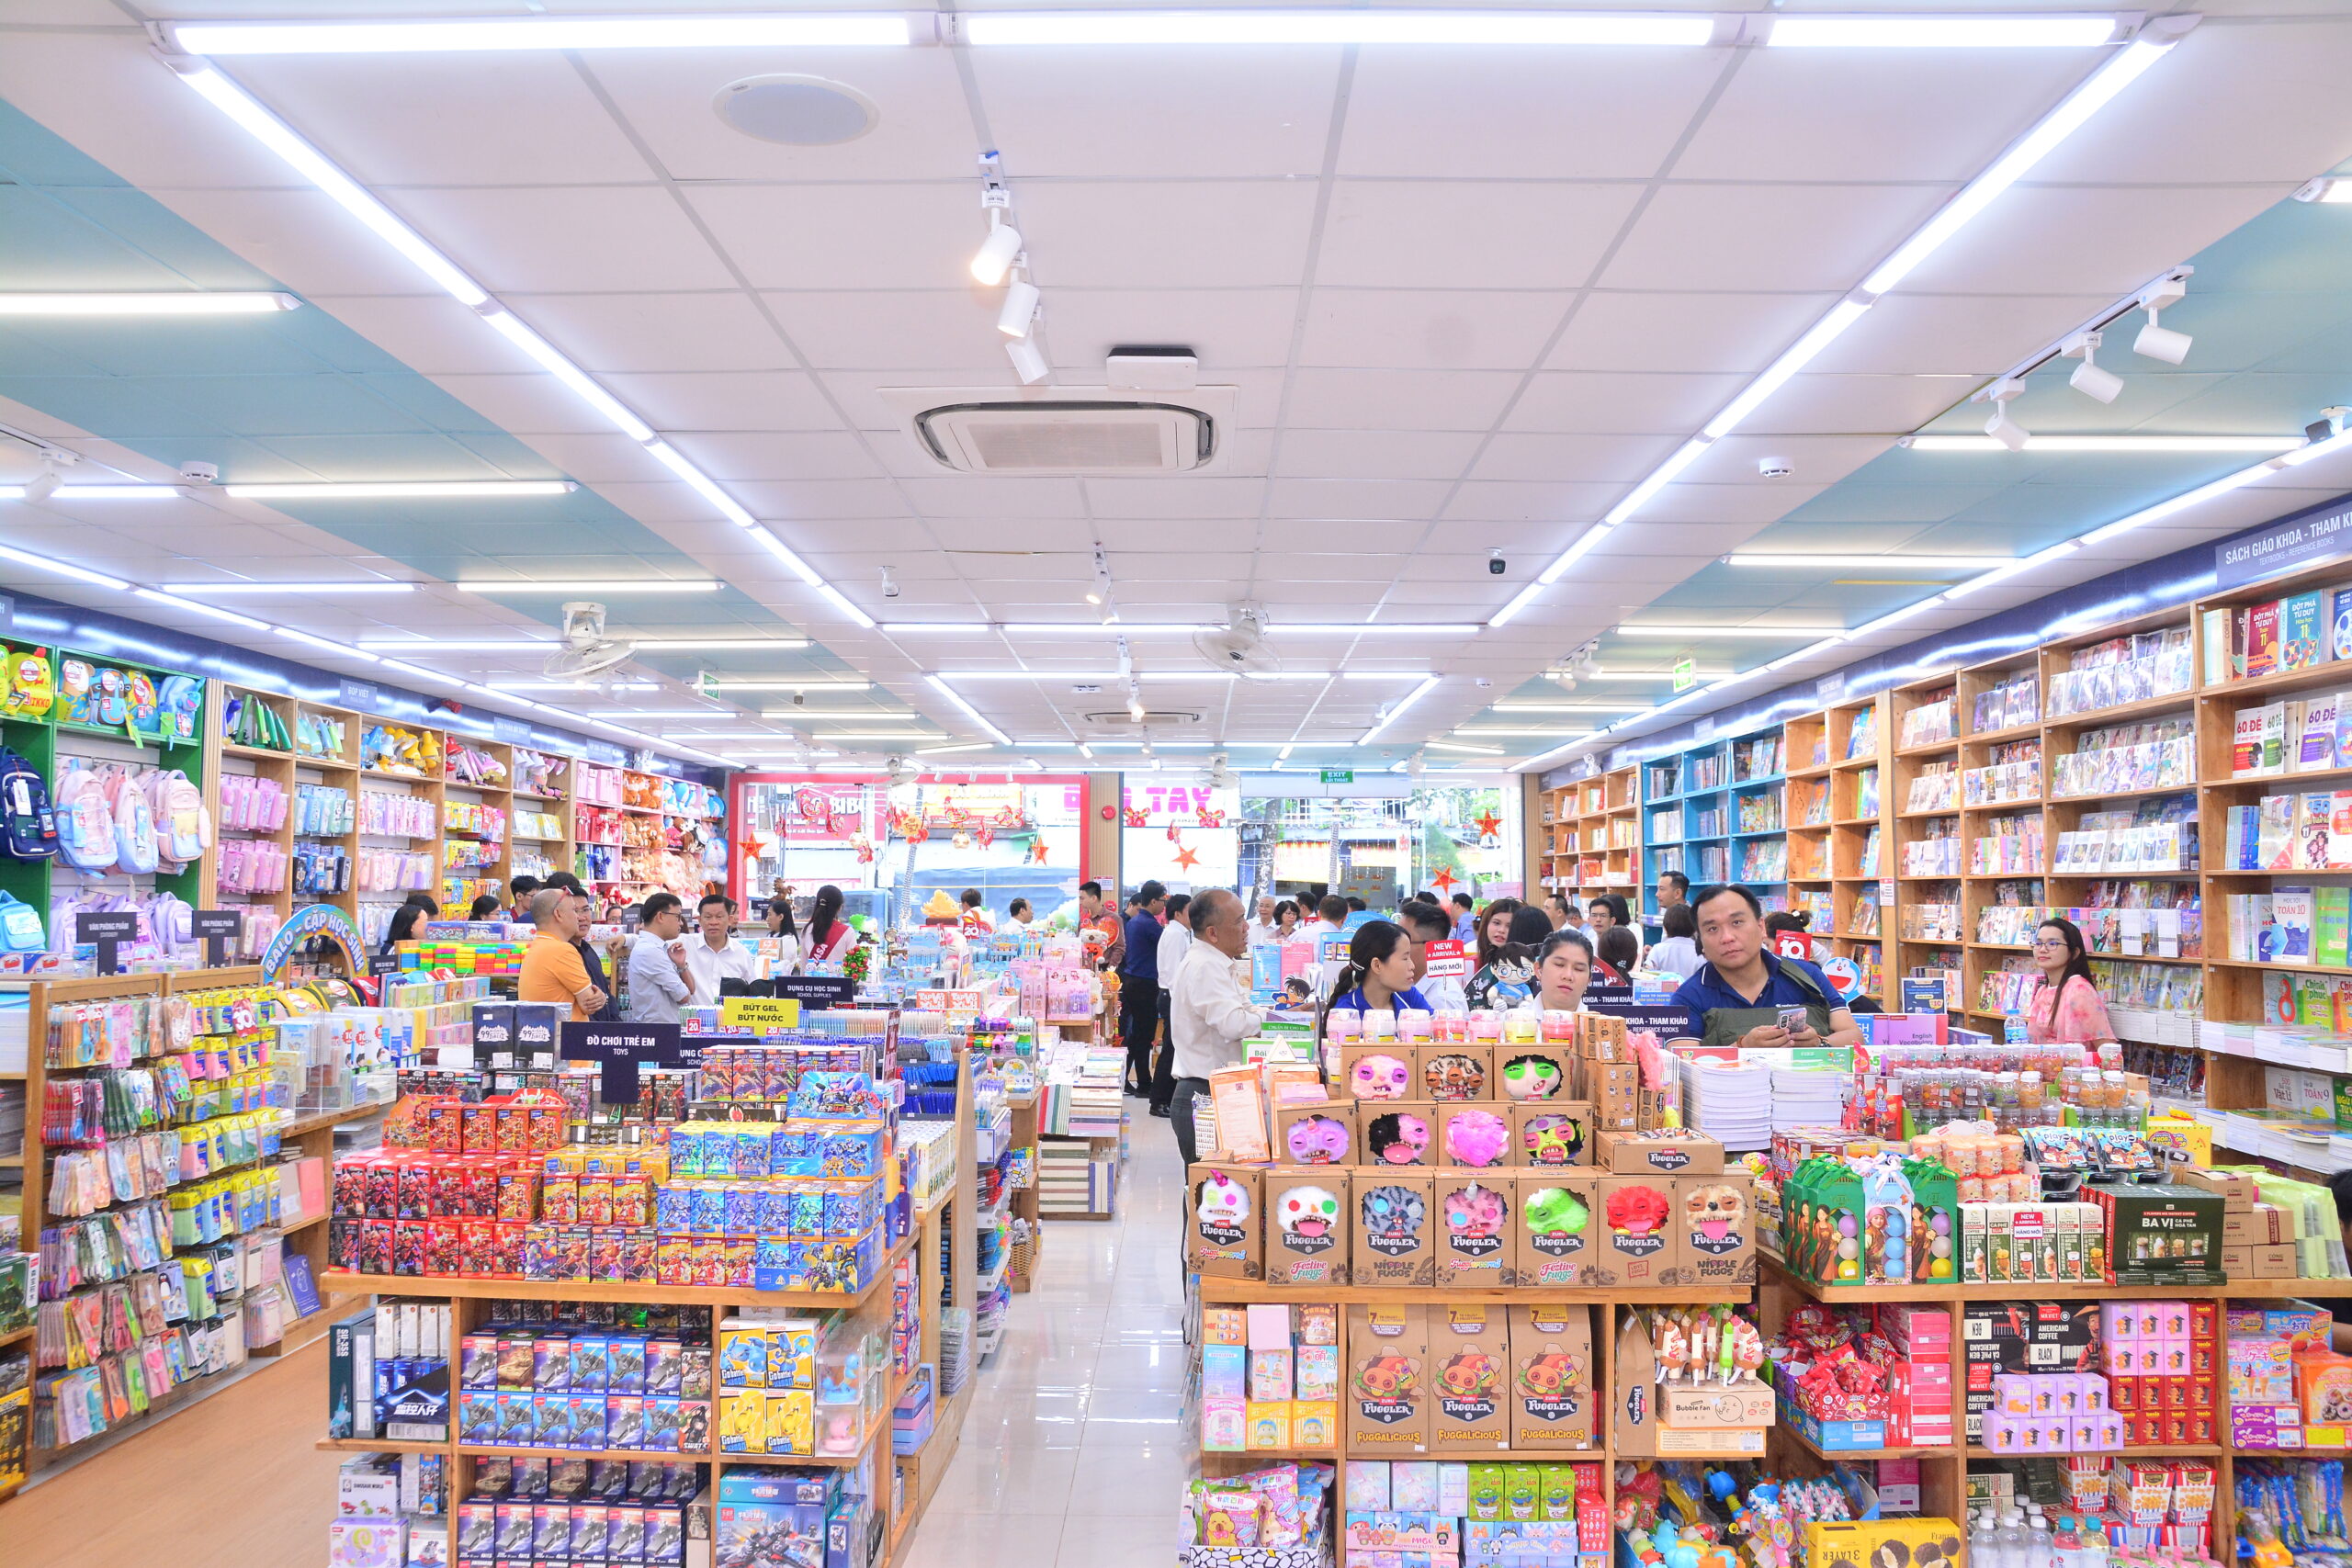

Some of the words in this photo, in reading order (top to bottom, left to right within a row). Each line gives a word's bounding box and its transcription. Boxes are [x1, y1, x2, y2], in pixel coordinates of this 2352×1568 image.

[2225, 545, 2250, 565] SÁCH
[2252, 536, 2274, 557] GIÁO
[2276, 528, 2302, 549] KHOA
[2310, 514, 2340, 538] THAM
[2259, 551, 2285, 566] TEXTBOOKS
[2289, 543, 2316, 558] REFERENCE
[2316, 536, 2335, 550] BOOKS
[2309, 710, 2320, 724] 60
[2236, 721, 2247, 734] 60
[2277, 905, 2296, 915] TOÁN
[2297, 905, 2306, 915] 10
[266, 931, 294, 975] BALO
[304, 906, 326, 935] CẶP
[328, 912, 349, 938] HỌC
[345, 931, 366, 973] SINH
[1434, 942, 1453, 951] NEW
[1429, 962, 1447, 972] HÀNG
[1448, 962, 1463, 970] MỚI
[787, 985, 804, 993] DỤNG
[805, 985, 813, 994] CỤ
[814, 986, 827, 995] HỌC
[828, 986, 842, 994] SINH
[743, 1003, 761, 1011] BÚT
[763, 1004, 779, 1012] GEL
[738, 1012, 755, 1021] BÚT
[757, 1013, 784, 1022] NƯỚC
[1669, 1015, 1689, 1024] KHẢO
[586, 1033, 600, 1046] ĐỒ
[601, 1035, 623, 1046] CHƠI
[624, 1033, 640, 1046] TRẺ
[641, 1036, 656, 1046] EM
[613, 1048, 629, 1056] TOYS
[2304, 1088, 2323, 1100] TOÁN
[1650, 1154, 1689, 1163] FUGGLER
[2142, 1217, 2159, 1227] BA
[2161, 1217, 2174, 1229] VỊ
[1202, 1224, 1244, 1239] FUGGLER
[1284, 1235, 1333, 1247] FUGGLER
[1370, 1235, 1418, 1247] FUGGLER
[1453, 1236, 1501, 1248] FUGGLER
[1534, 1236, 1582, 1248] FUGGLER
[1615, 1235, 1664, 1247] FUGGLER
[1693, 1234, 1742, 1246] FUGGLER
[1291, 1258, 1328, 1273] Festive
[1540, 1260, 1577, 1276] Festive
[1377, 1269, 1410, 1278] FUGGS
[1701, 1268, 1734, 1277] FUGGS
[1369, 1312, 1377, 1323] 7
[1450, 1311, 1457, 1323] 7
[1532, 1310, 1539, 1322] 7
[2038, 1348, 2052, 1360] BLACK
[1363, 1403, 1412, 1416] FUGGLER
[1444, 1401, 1490, 1415] FUGGLER
[1528, 1400, 1575, 1413] FUGGLER
[1634, 1387, 1642, 1424] FUGGLER
[1968, 1419, 1982, 1431] BLACK
[1356, 1431, 1420, 1445] FUGGALICIOUS
[1438, 1429, 1502, 1443] FUGGALICIOUS
[1521, 1428, 1585, 1441] FUGGALICIOUS
[1823, 1551, 1852, 1561] LAYER
[1853, 1550, 1860, 1560] 3
